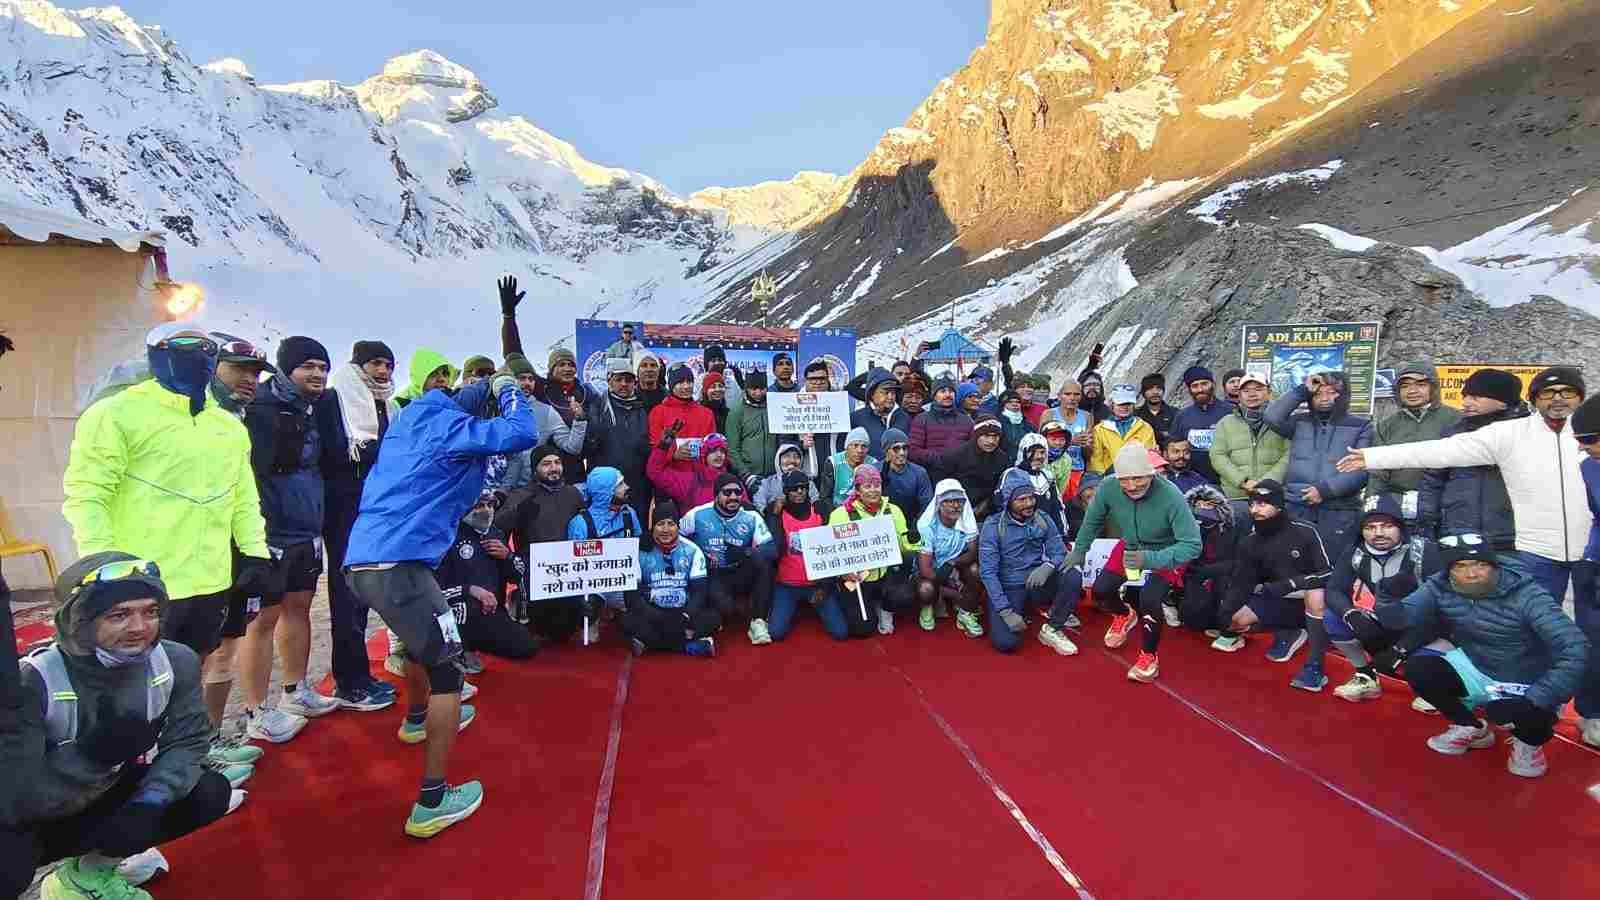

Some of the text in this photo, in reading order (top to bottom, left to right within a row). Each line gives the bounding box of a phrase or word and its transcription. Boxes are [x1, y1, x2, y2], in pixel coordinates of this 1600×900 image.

[1265, 332, 1289, 342] ADI
[1293, 331, 1354, 343] KAILASH
[537, 555, 633, 578] “खुद को जगाओ
[542, 573, 634, 594] नशे को भगाओ”
